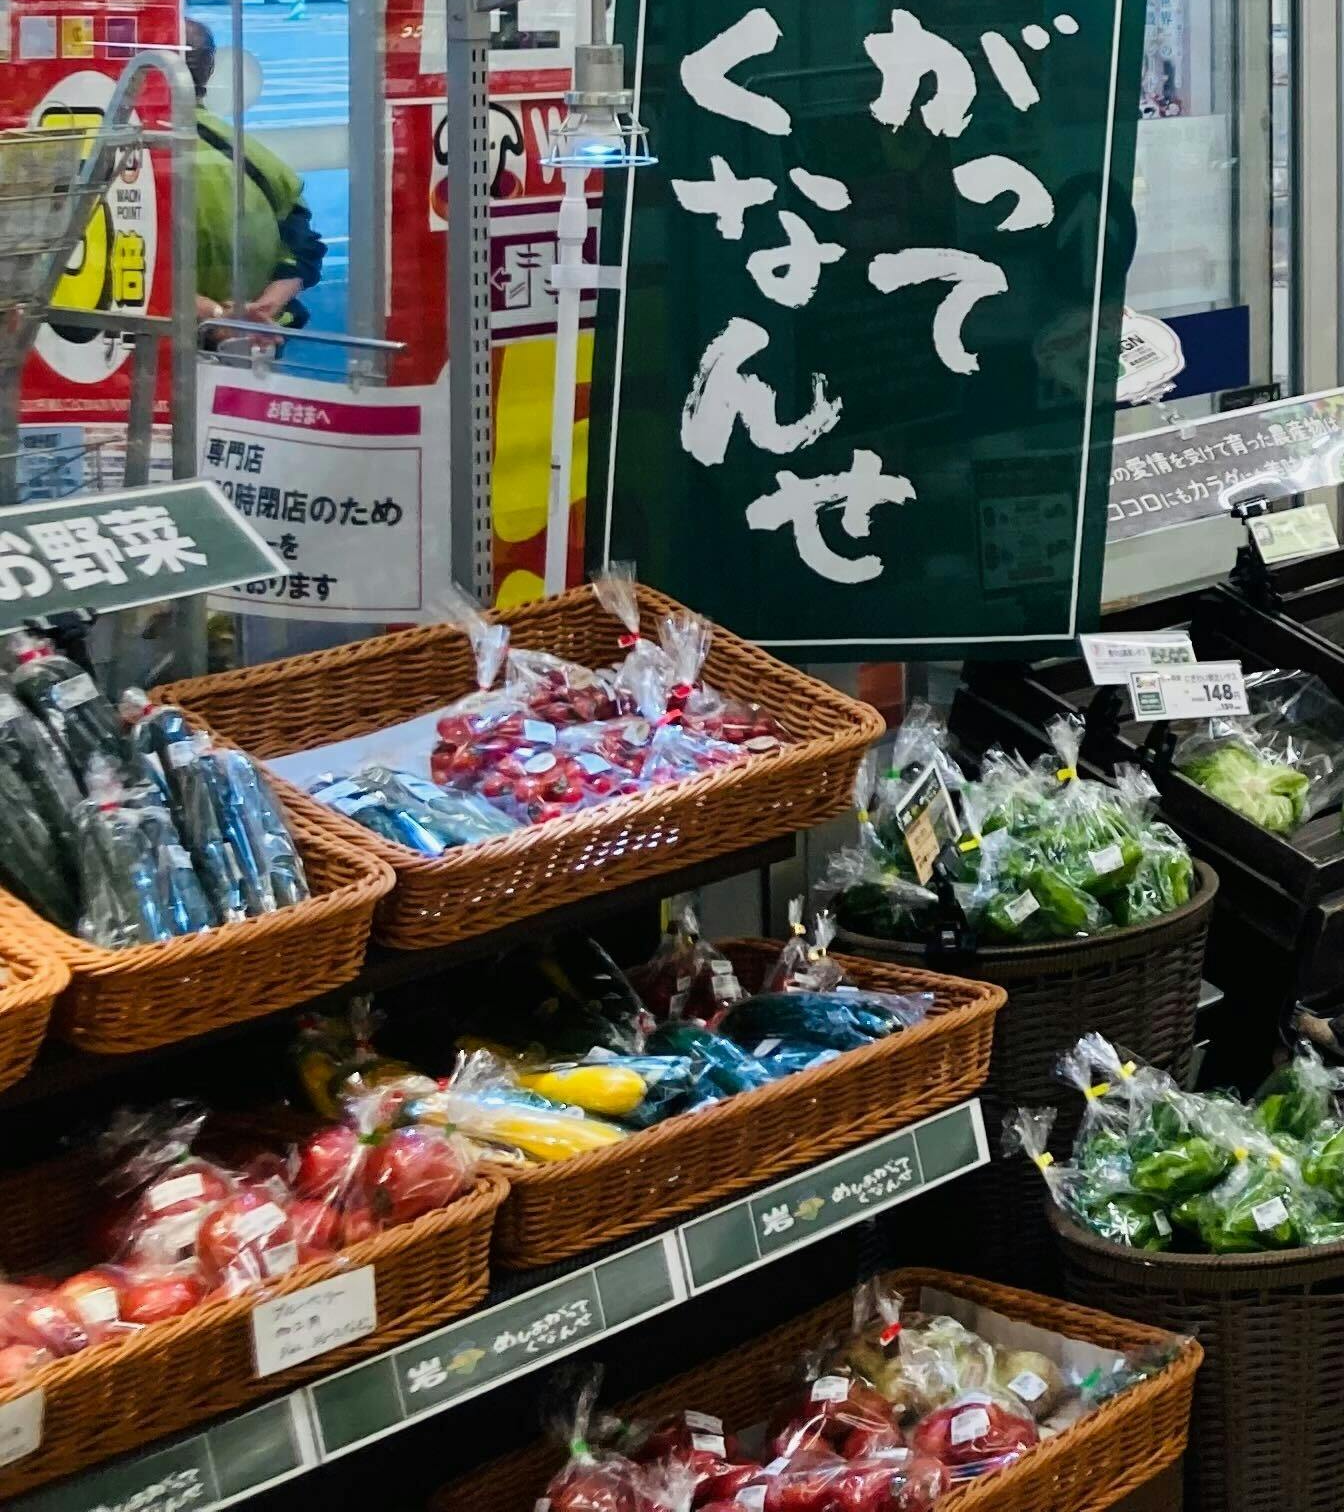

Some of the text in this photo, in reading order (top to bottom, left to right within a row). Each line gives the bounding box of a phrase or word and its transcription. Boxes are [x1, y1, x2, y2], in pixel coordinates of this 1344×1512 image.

[116, 205, 143, 220] POINT
[671, 8, 917, 586] くなんせ
[206, 438, 266, 474] 専門店
[1110, 417, 1343, 487] の愛情を受けて育った農産物は
